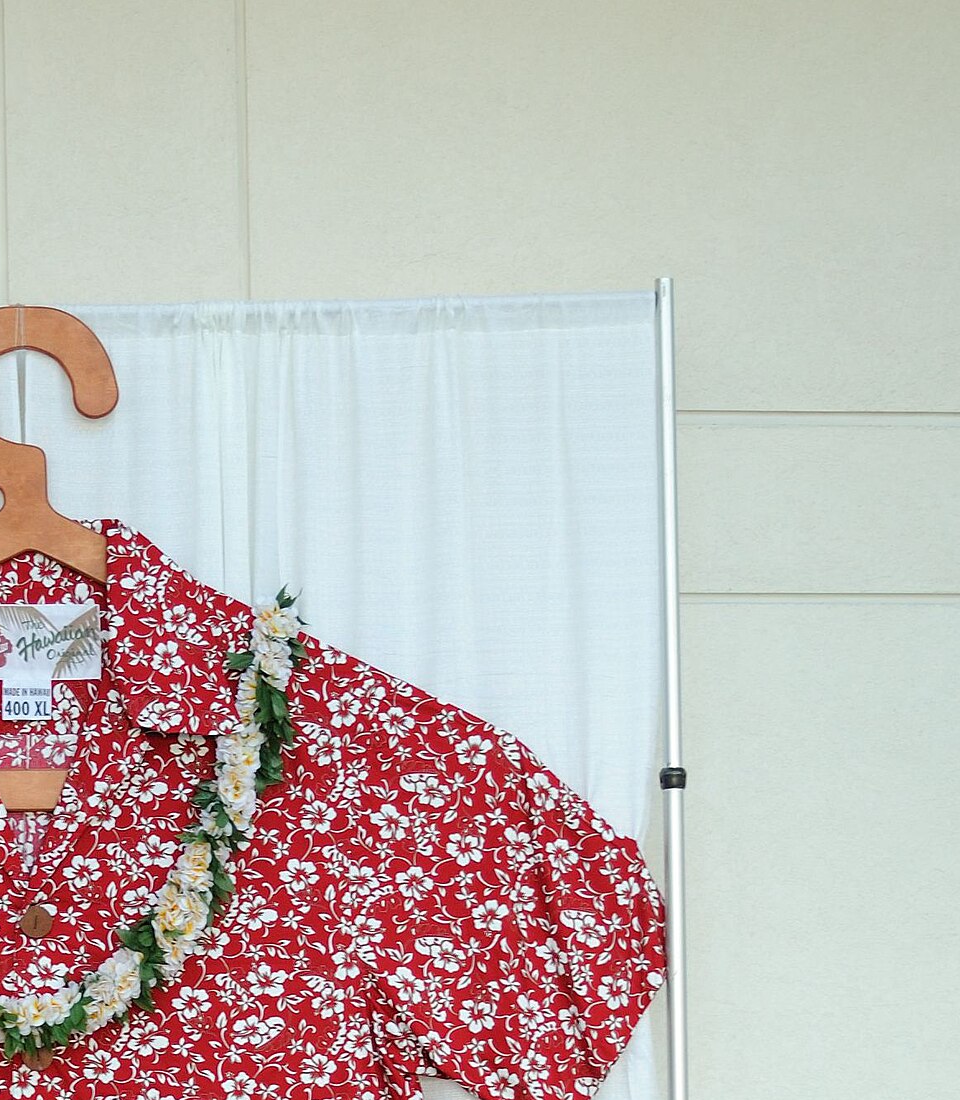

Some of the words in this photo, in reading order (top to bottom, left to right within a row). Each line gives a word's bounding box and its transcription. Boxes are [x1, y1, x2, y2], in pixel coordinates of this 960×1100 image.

[16, 624, 97, 662] Hawaiian
[4, 688, 21, 697] MADE
[21, 688, 28, 696] IN
[5, 701, 30, 716] 400
[34, 701, 51, 717] XL
